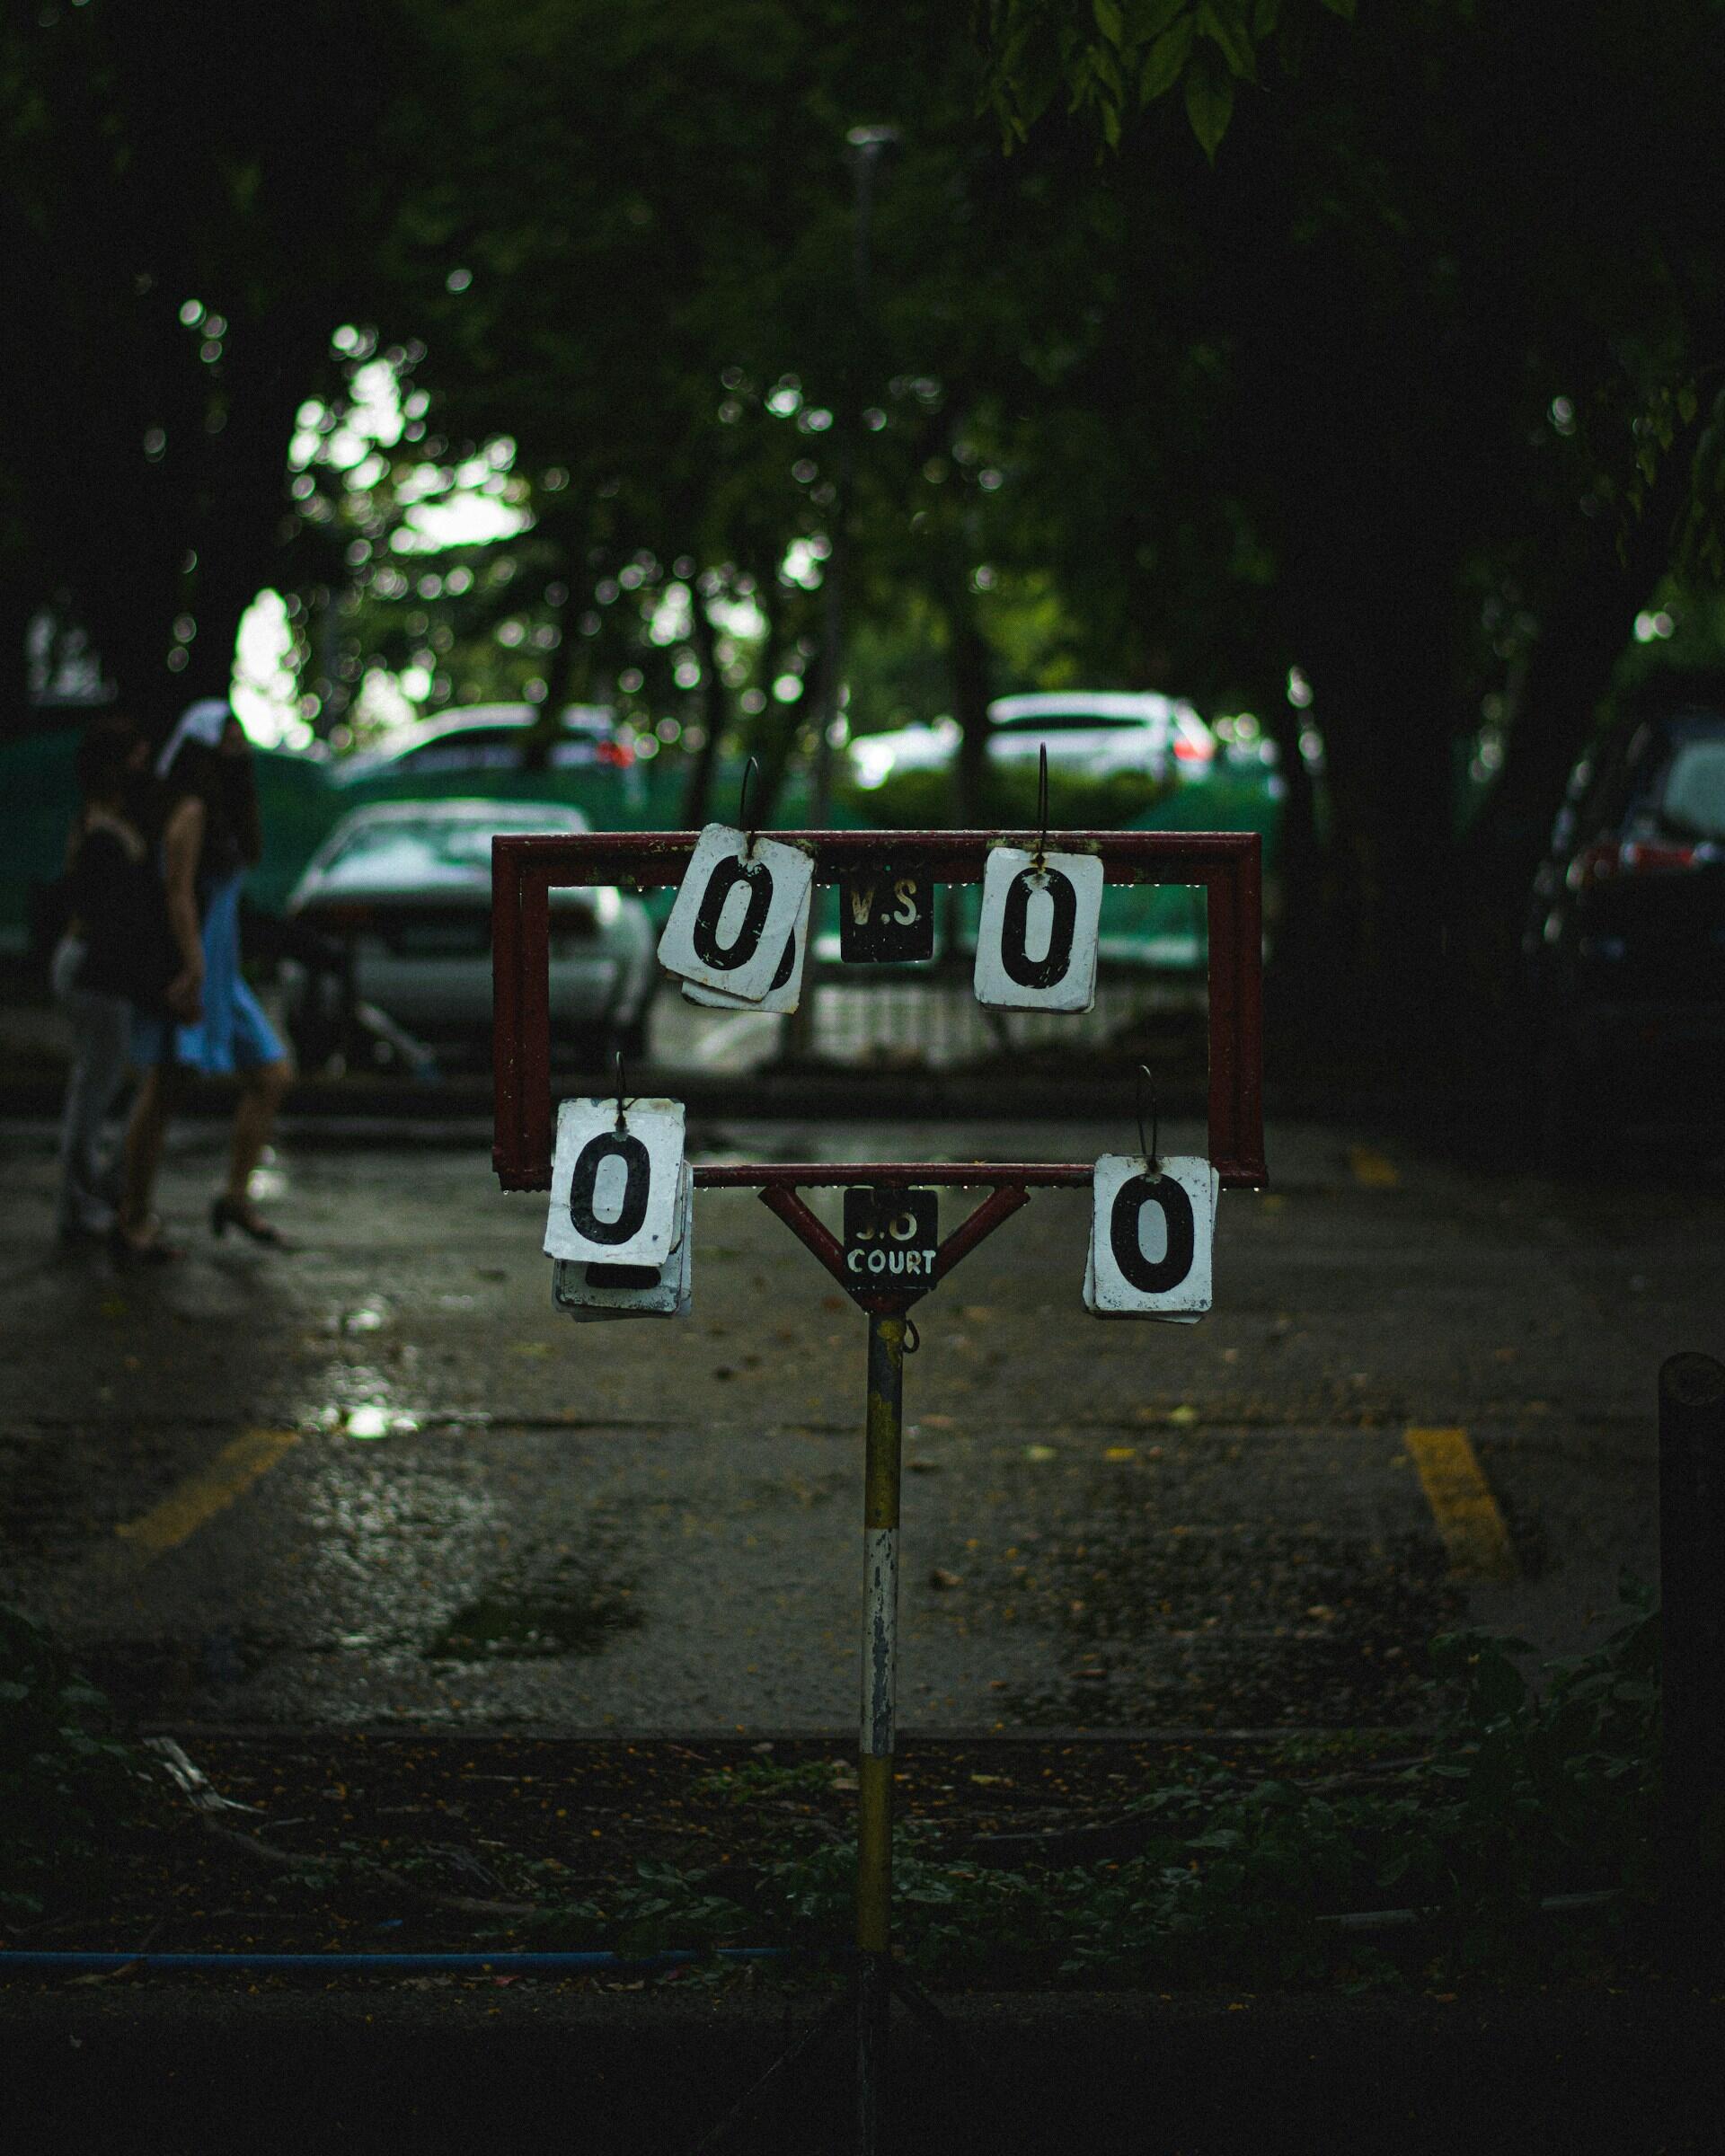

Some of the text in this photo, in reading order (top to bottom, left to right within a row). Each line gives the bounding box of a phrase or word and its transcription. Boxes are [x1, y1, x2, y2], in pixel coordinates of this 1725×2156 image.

[693, 854, 774, 971] 0
[1001, 867, 1077, 989] 0
[570, 1131, 650, 1245] 0
[1110, 1173, 1195, 1294] 0
[847, 1249, 937, 1275] COURT
